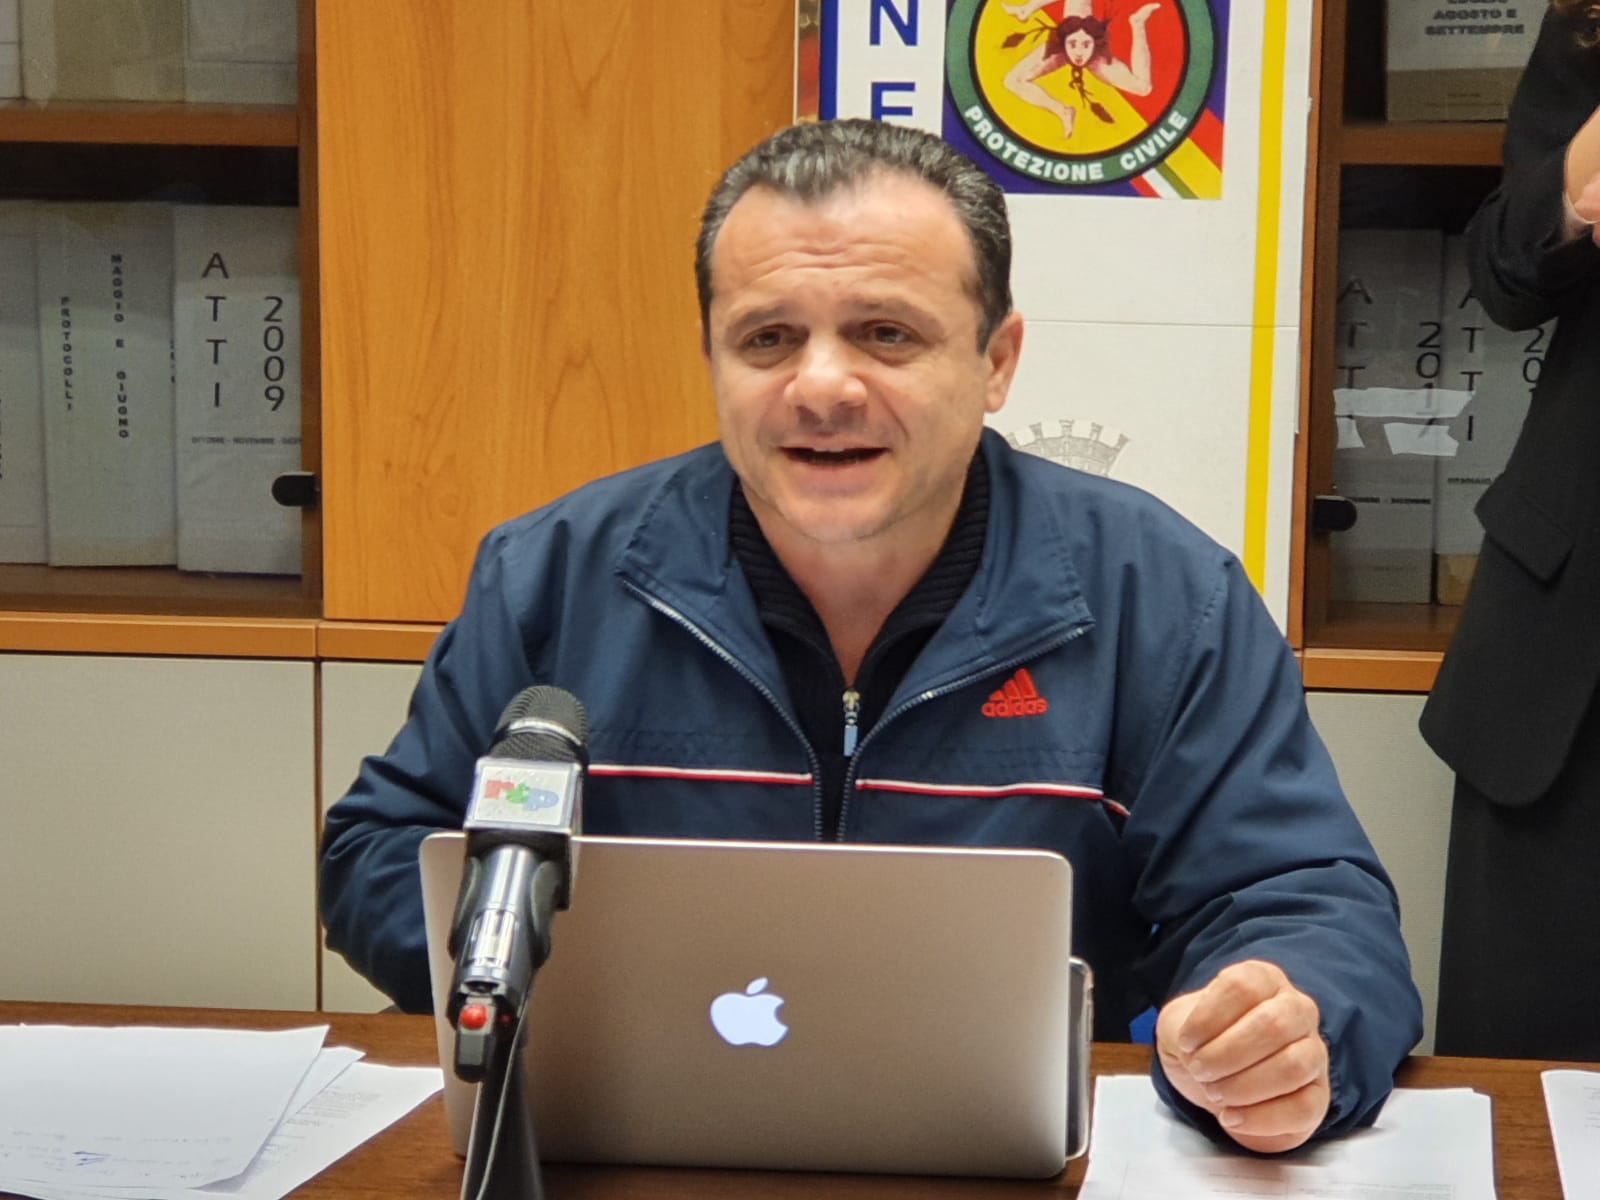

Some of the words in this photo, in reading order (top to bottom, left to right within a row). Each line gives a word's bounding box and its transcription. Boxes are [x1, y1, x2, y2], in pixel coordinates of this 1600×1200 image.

[1433, 9, 1501, 20] AGOSTO
[1507, 9, 1517, 18] E
[965, 105, 1103, 181] PROTEZIONE
[1120, 111, 1188, 171] CIVILE
[61, 297, 73, 411] PROTOCOLLI
[202, 252, 229, 407] ATTI
[263, 296, 285, 411] 2009
[981, 698, 1048, 718] adidas
